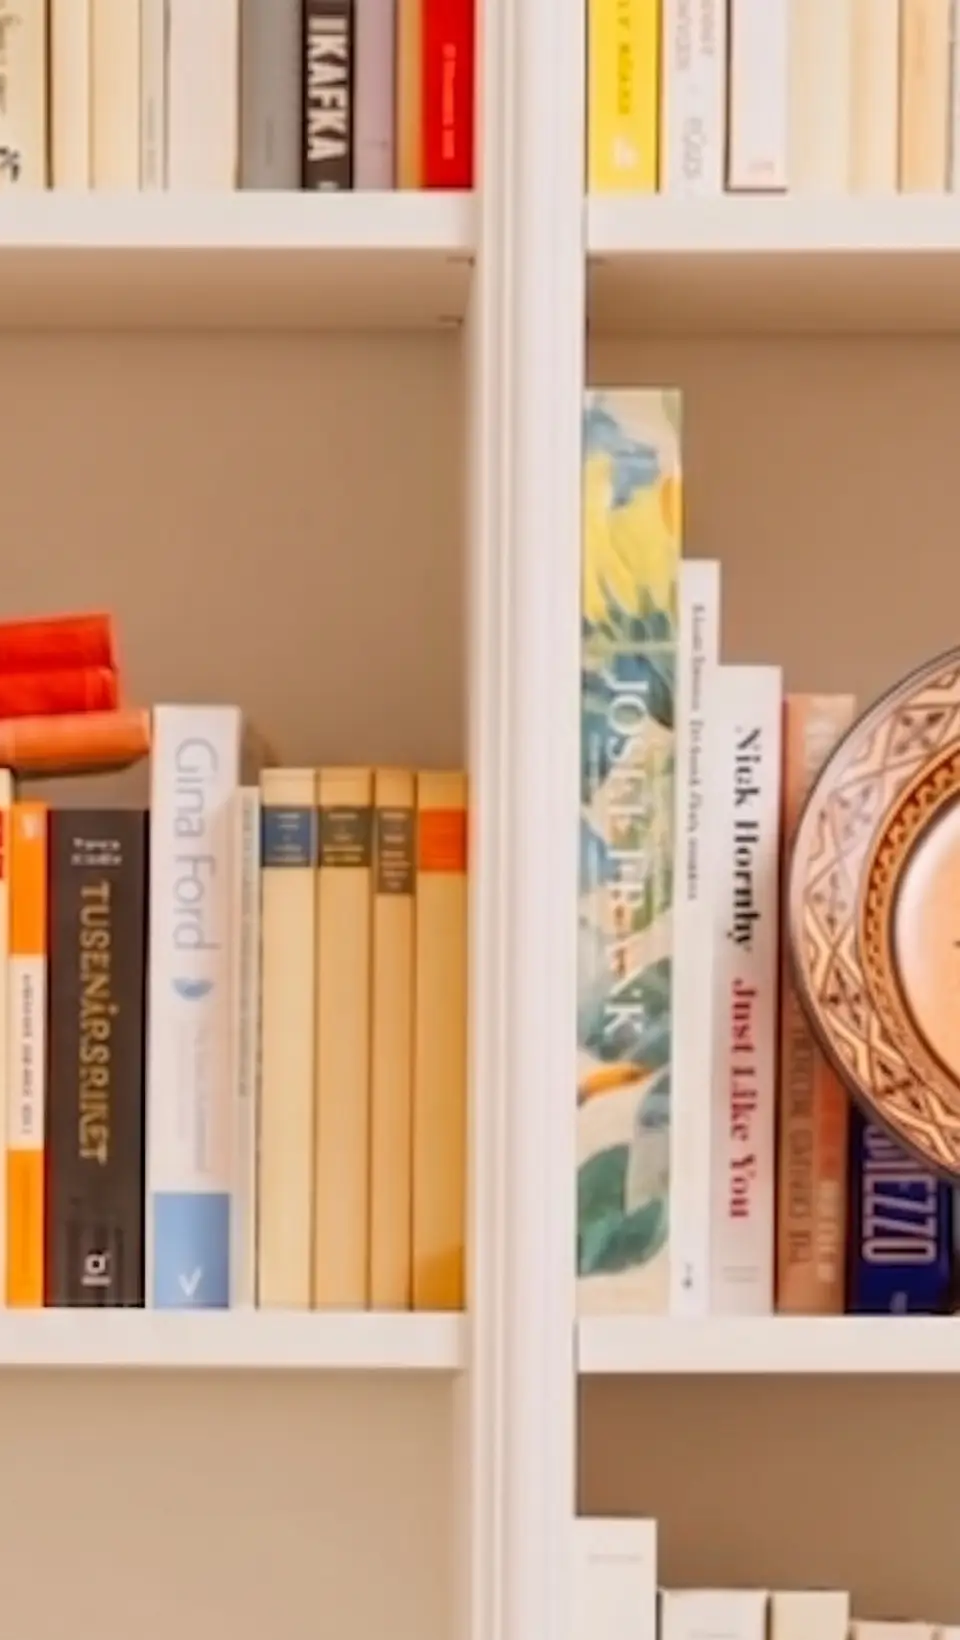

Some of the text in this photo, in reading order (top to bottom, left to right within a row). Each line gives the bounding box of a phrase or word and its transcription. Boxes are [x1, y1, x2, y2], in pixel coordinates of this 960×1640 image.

[172, 736, 223, 952] Gina Ford
[726, 725, 762, 1220] Nick Hornby Just Like You
